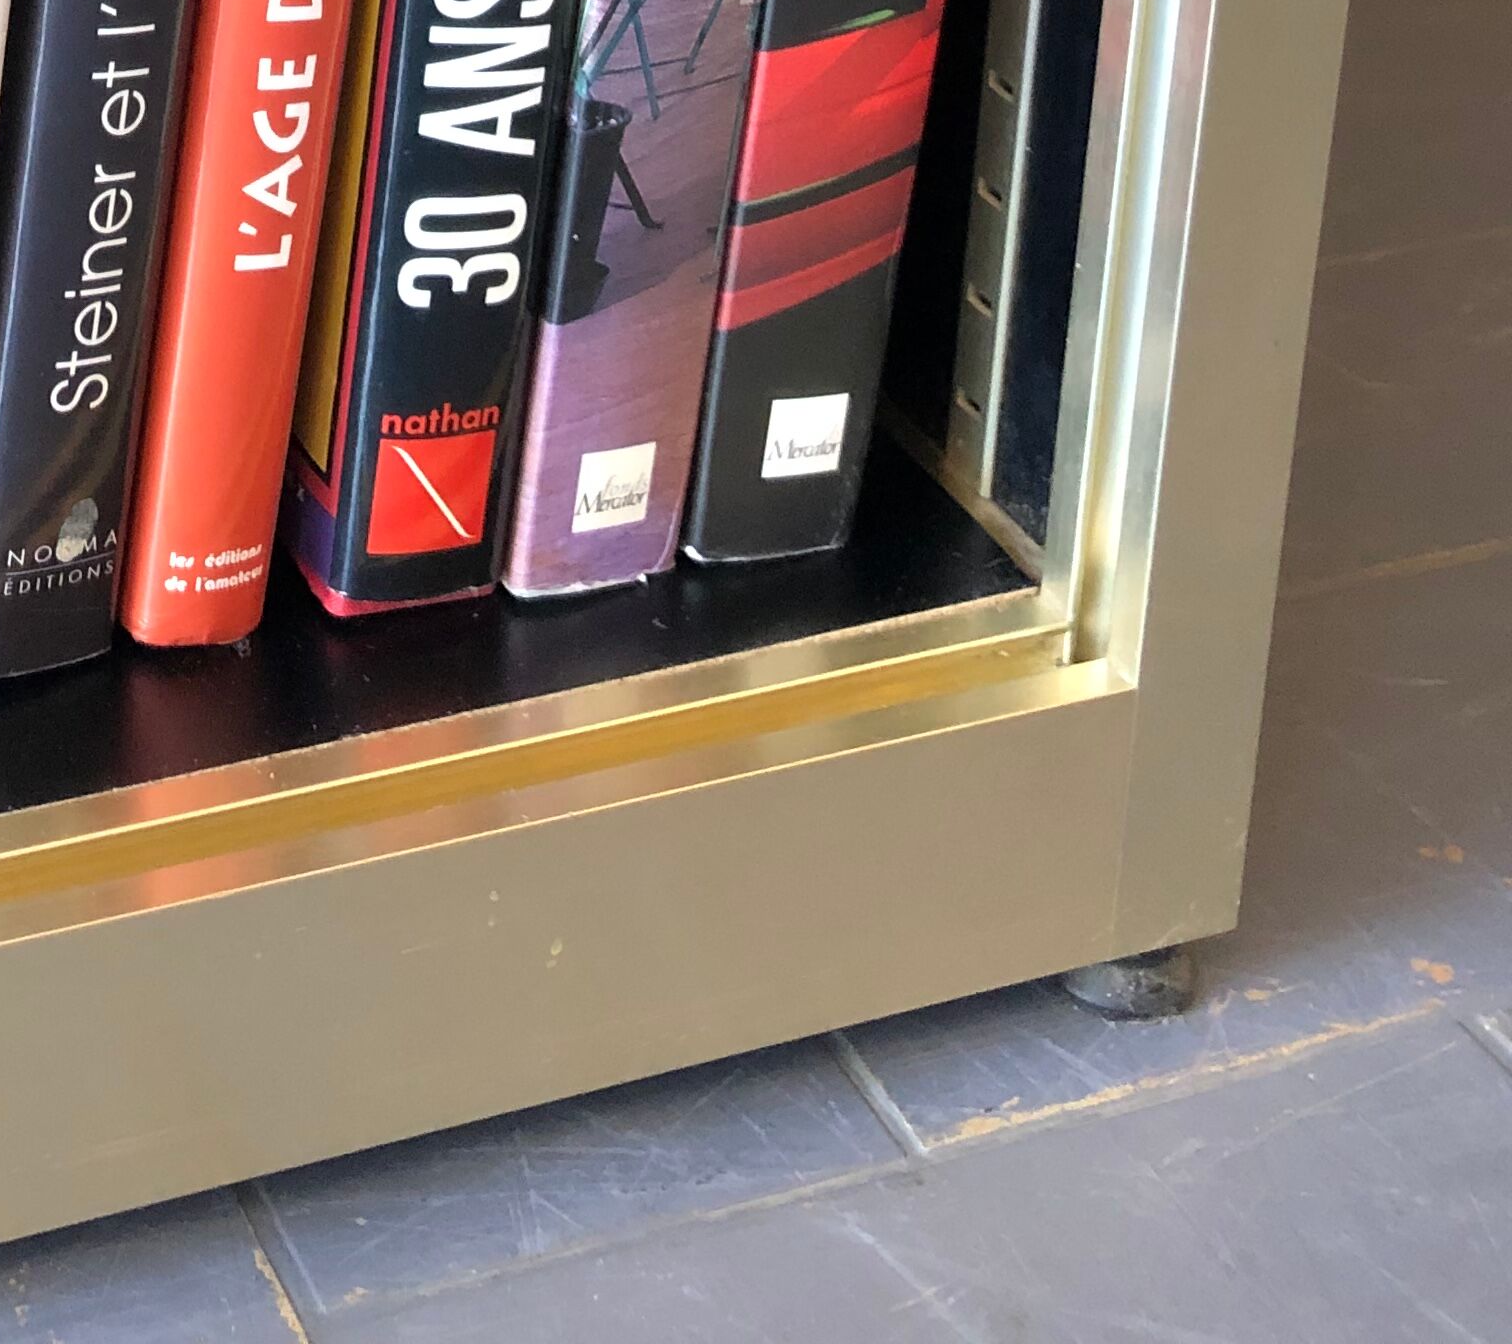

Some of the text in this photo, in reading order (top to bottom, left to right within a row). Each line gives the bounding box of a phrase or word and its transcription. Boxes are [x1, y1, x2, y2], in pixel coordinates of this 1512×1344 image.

[91, 60, 150, 135] et
[234, 54, 317, 272] L'AGE
[397, 193, 527, 309] 30
[50, 164, 136, 412] Steiner
[380, 403, 500, 435] nathan
[6, 529, 117, 568] NOMA
[169, 544, 262, 568] les éditions
[3, 560, 114, 596] ÉDITIONS
[165, 565, 263, 592] de l'amateur
